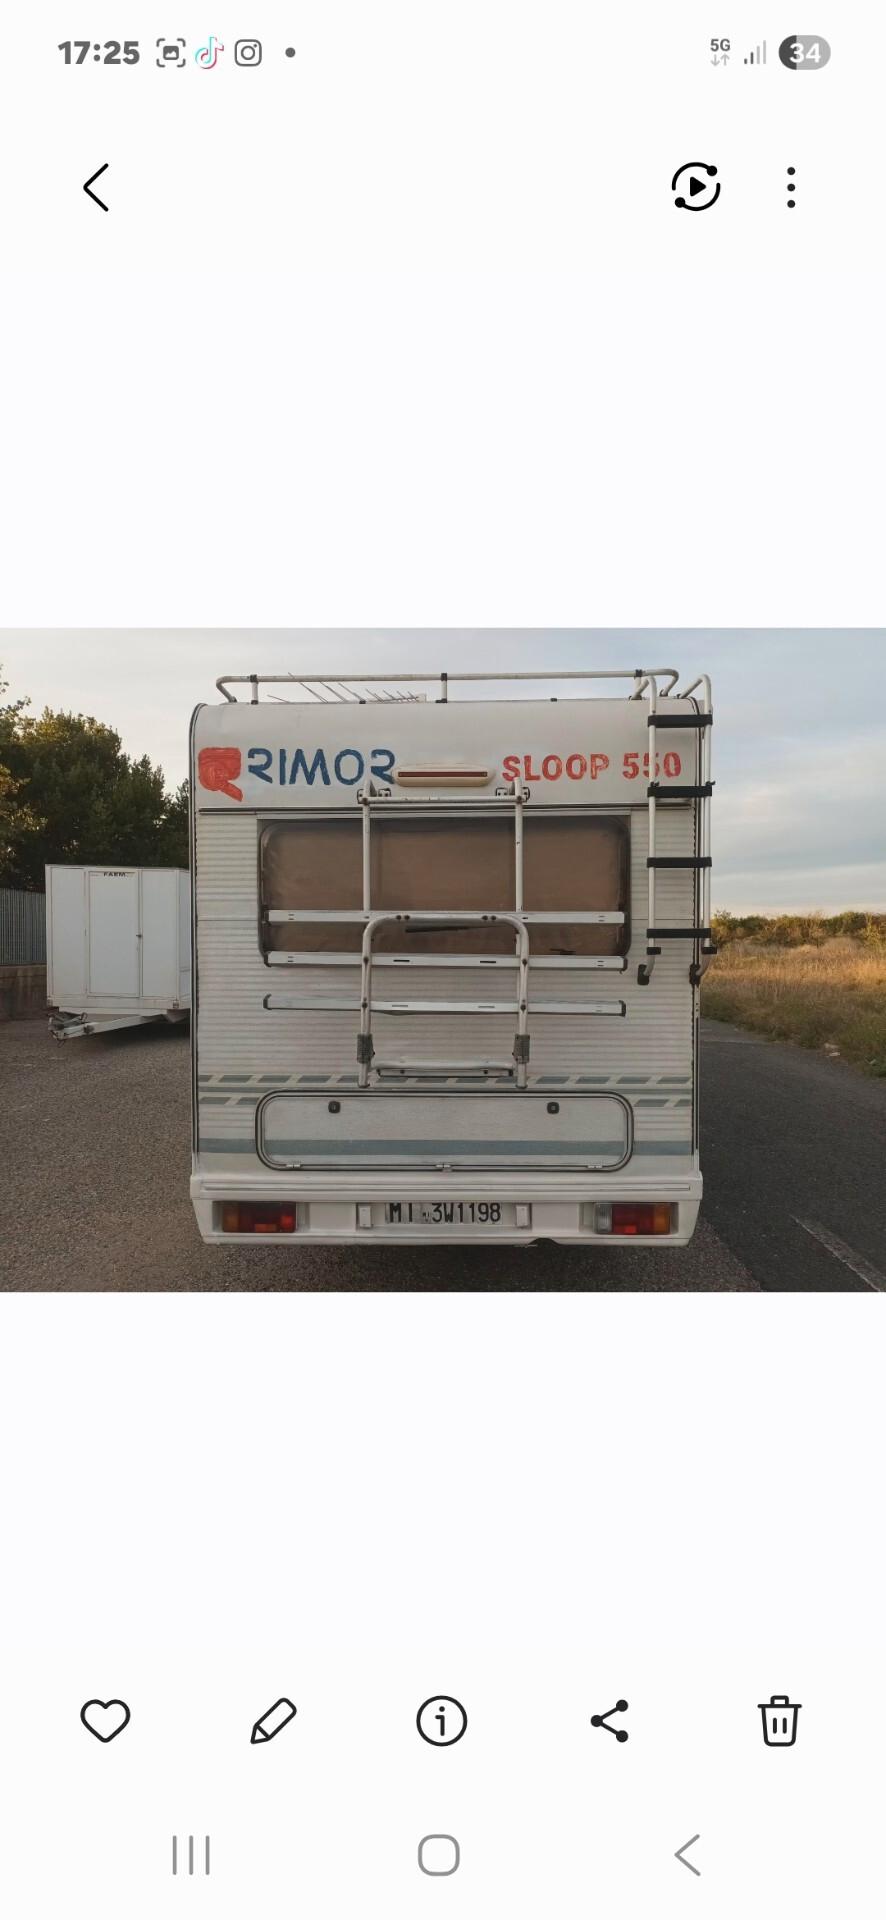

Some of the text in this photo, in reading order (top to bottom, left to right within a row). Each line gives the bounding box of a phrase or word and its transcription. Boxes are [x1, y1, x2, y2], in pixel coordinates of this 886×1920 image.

[247, 747, 396, 786] RIMOR
[502, 751, 682, 782] SLOOP 550
